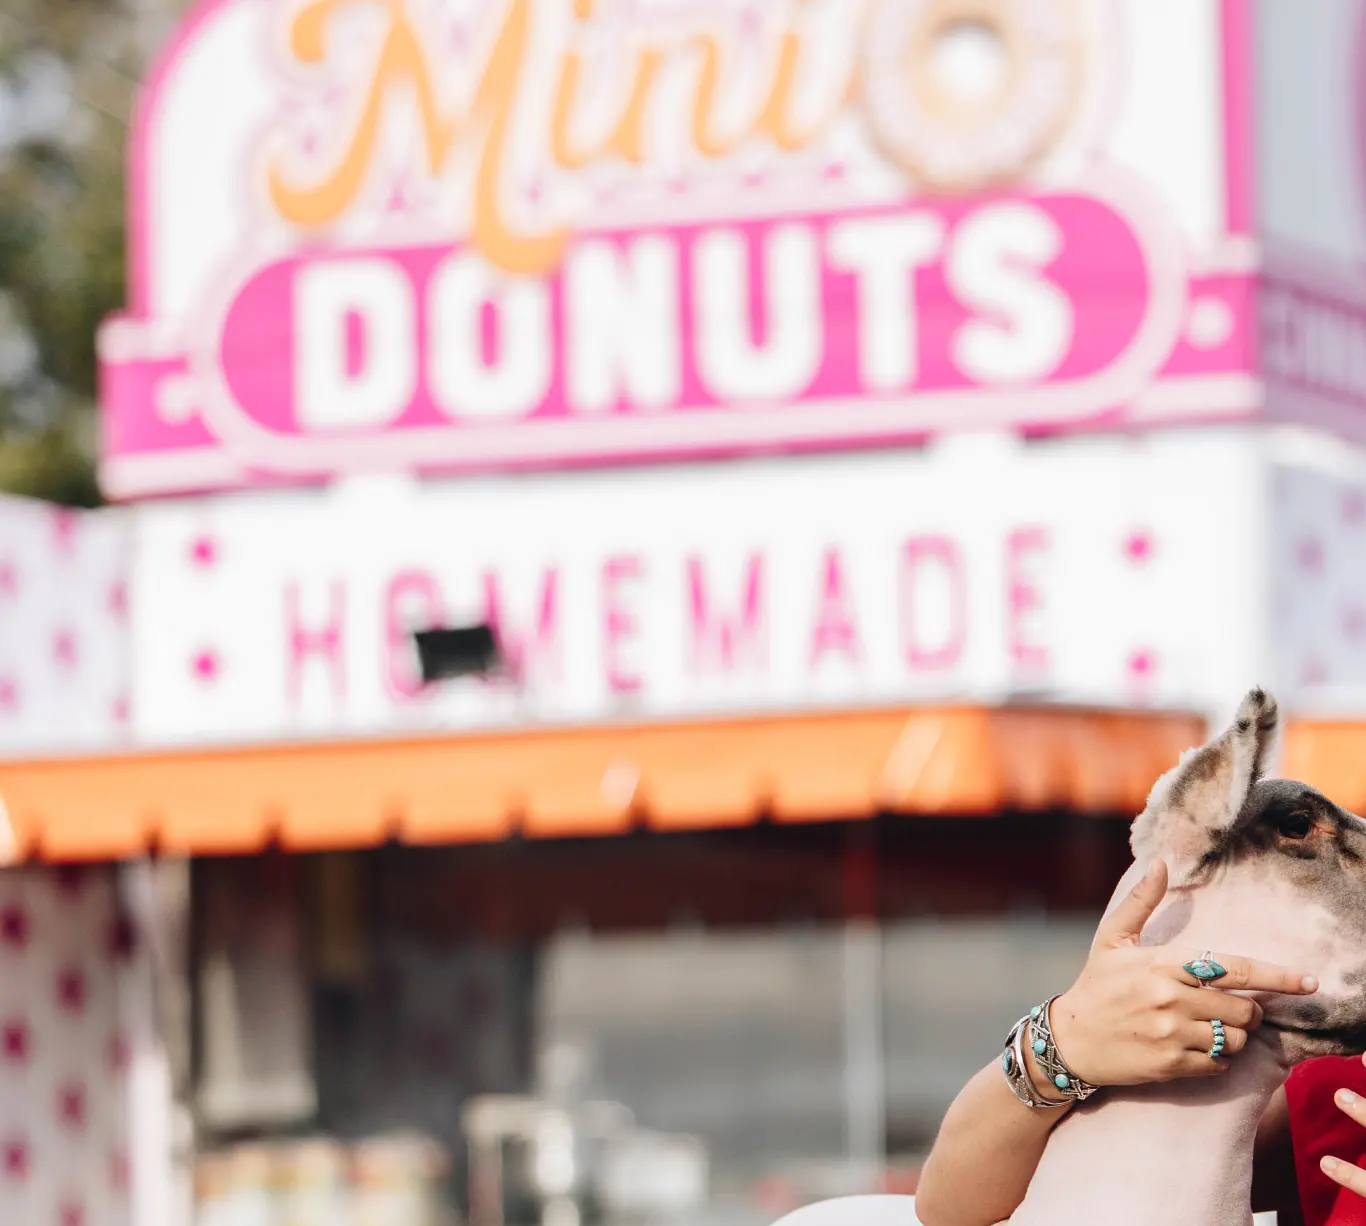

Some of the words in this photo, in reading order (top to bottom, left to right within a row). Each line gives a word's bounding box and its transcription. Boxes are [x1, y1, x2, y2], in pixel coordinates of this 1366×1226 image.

[265, 0, 866, 276] Mini
[292, 202, 1074, 433] DONUTS
[283, 525, 1057, 709] HOMEMADE
